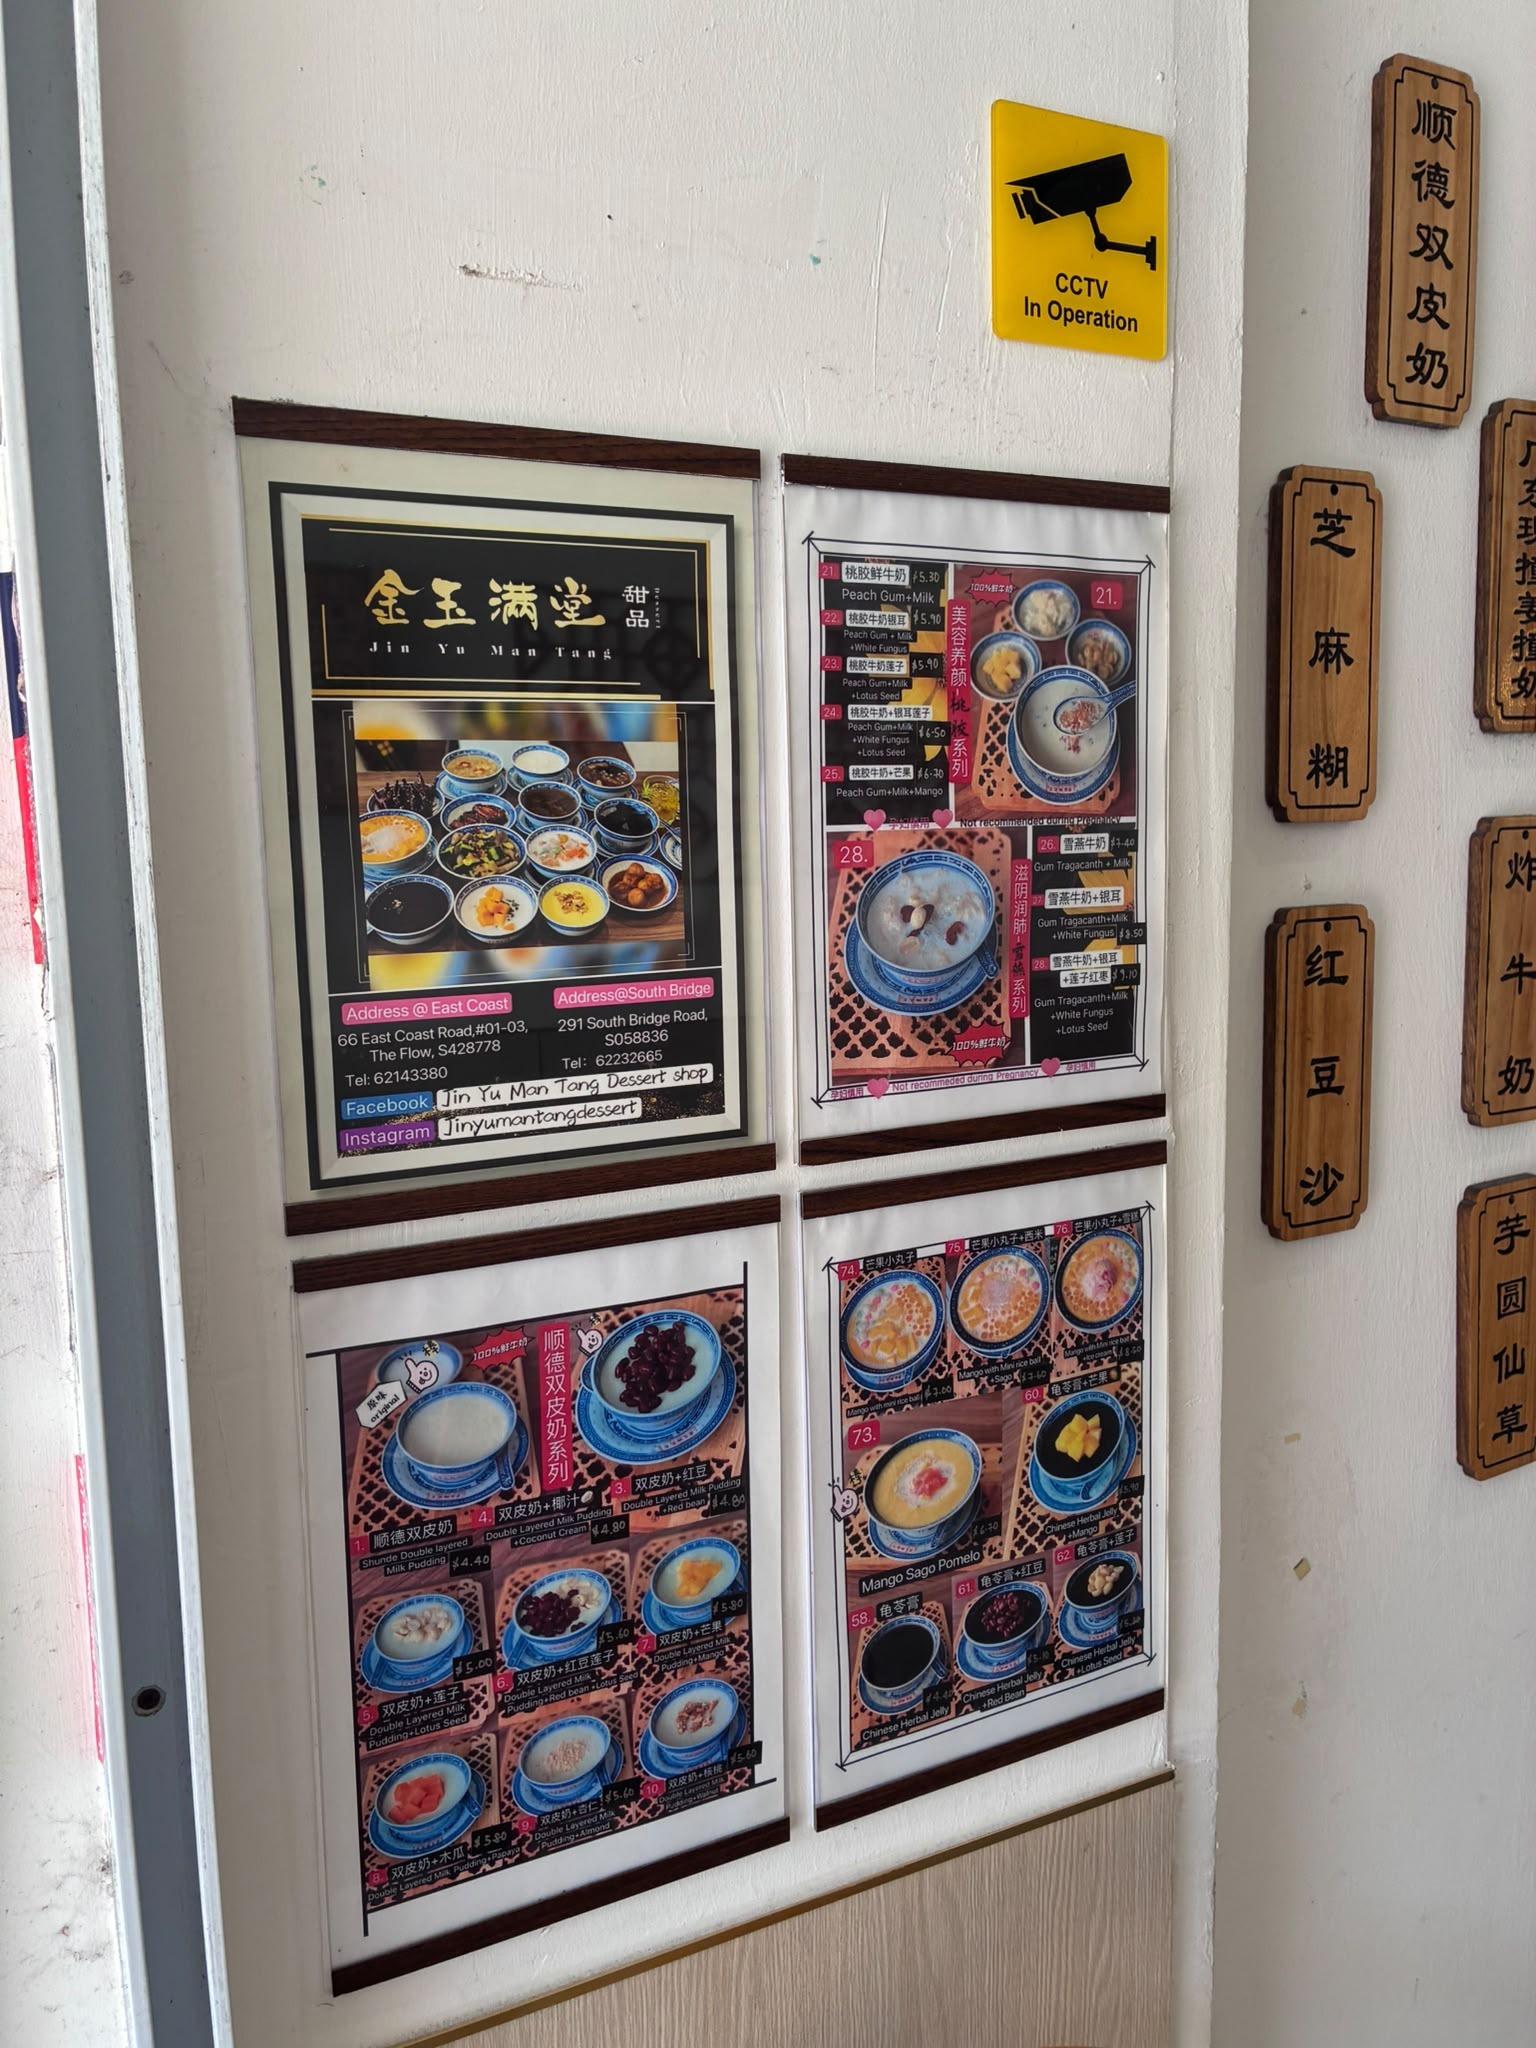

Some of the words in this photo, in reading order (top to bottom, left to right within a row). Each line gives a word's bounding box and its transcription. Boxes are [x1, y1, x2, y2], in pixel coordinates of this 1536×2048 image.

[1405, 98, 1457, 389] 顺德双皮奶
[1055, 273, 1108, 299] CCTV
[1024, 296, 1041, 317] In
[1048, 300, 1138, 333] Operation
[845, 565, 906, 582] 桃胶鲜牛奶
[364, 569, 606, 630] 金玉满堂
[622, 585, 650, 628] 甜品
[842, 589, 877, 601] Peach
[880, 590, 935, 604] Gum+Milk
[1095, 586, 1117, 606] 21.
[370, 641, 410, 654] Jin
[438, 643, 465, 656] Yu
[491, 644, 537, 657] Man
[555, 646, 611, 661] Tang
[1306, 508, 1356, 789] 芝麻糊
[836, 787, 862, 798] Peach
[840, 845, 868, 863] 28.
[1034, 862, 1054, 872] Gum
[1057, 860, 1103, 873] Tragacanth
[1084, 927, 1115, 939] Fungus
[1497, 850, 1536, 1096] 炸牛奶
[669, 982, 711, 998] Bridge
[1034, 998, 1055, 1008] Gum
[1058, 991, 1128, 1006] Tragacanth+Milk
[346, 1005, 409, 1021] Address
[413, 1002, 428, 1017] @
[432, 999, 463, 1015] East
[466, 998, 509, 1012] Coast
[558, 1017, 583, 1032] 291
[586, 1014, 626, 1030] South
[629, 1012, 670, 1028] Bridge
[673, 1008, 708, 1023] Road,
[1083, 1007, 1114, 1018] Fungus
[1087, 1021, 1108, 1031] Seed
[338, 1033, 358, 1047] 66
[362, 1031, 391, 1045] East
[395, 1028, 434, 1043] Coast
[604, 1029, 669, 1047] S058836
[369, 1049, 397, 1063] The
[400, 1046, 435, 1061] Flow,
[438, 1039, 501, 1057] S428778
[562, 1057, 588, 1070] Tel:
[595, 1050, 663, 1067] 62232665
[345, 1074, 371, 1088] Tel:
[373, 1066, 448, 1085] 62143380
[892, 1082, 908, 1092] Not
[967, 1073, 993, 1084] during
[996, 1068, 1040, 1081] Pregnancy
[1300, 945, 1349, 1206] 红豆沙
[346, 1095, 429, 1116] Facebook
[440, 1088, 471, 1107] Jin
[478, 1085, 501, 1101] Yu
[510, 1082, 549, 1099] Man
[554, 1078, 600, 1096] Tang
[607, 1070, 667, 1088] Dessert
[672, 1066, 708, 1084] shop
[345, 1127, 430, 1147] Instagram
[443, 1100, 637, 1137] Jinyumantangdessert
[1492, 1212, 1531, 1444] 芋圆仙草
[544, 1328, 568, 1485] 顺德双皮奶系列
[852, 1427, 876, 1446] 73.
[374, 1519, 453, 1549] 顺德双皮奶
[486, 1528, 518, 1542] Double
[520, 1519, 555, 1534] Layered
[557, 1514, 574, 1526] Milk
[576, 1507, 612, 1521] Pudding
[558, 1525, 587, 1537] Cream
[362, 1554, 398, 1569] Shunde
[400, 1548, 433, 1561] Double
[386, 1563, 406, 1576] Milk
[408, 1555, 446, 1571] Pudding
[861, 1575, 903, 1593] Mango
[906, 1563, 936, 1581] Sago
[938, 1550, 981, 1569] Pomelo
[443, 1714, 467, 1728] Seed
[862, 1723, 899, 1740] Chinese
[900, 1712, 928, 1729] Herbal
